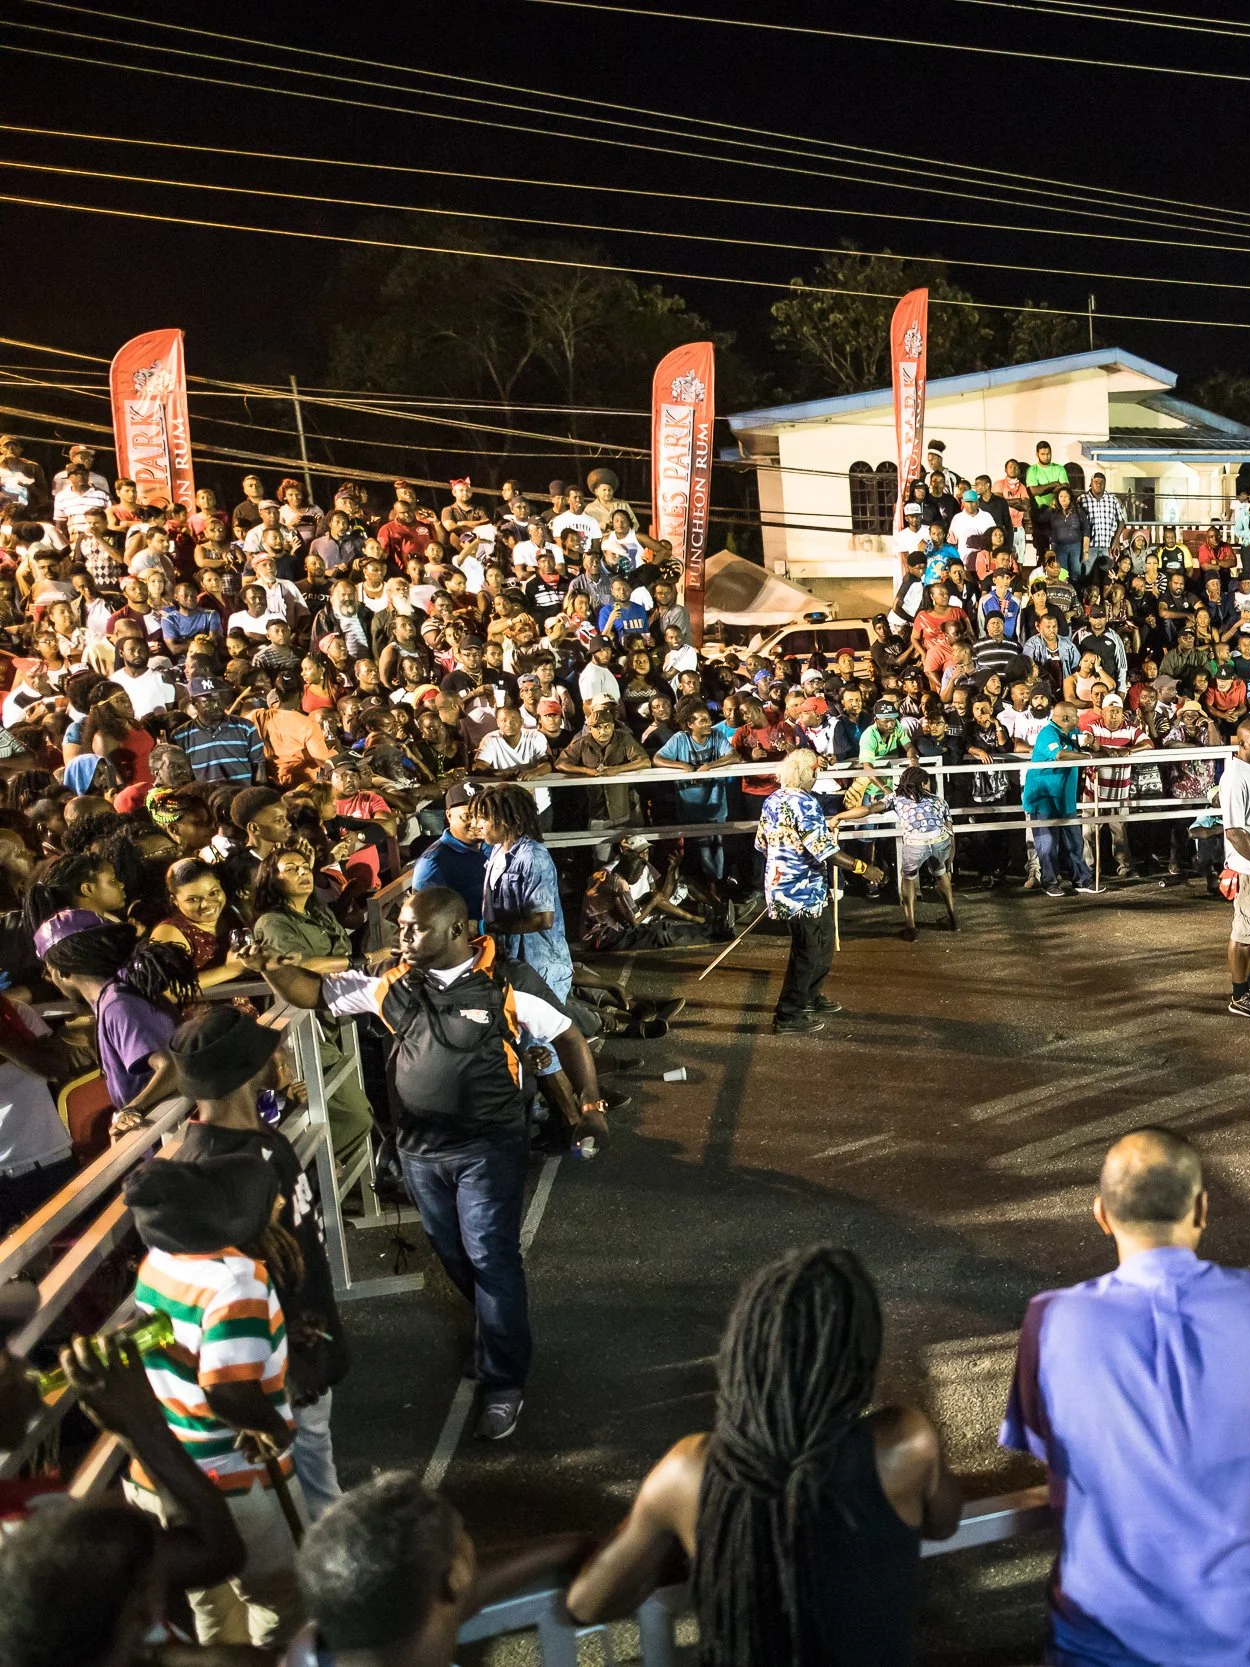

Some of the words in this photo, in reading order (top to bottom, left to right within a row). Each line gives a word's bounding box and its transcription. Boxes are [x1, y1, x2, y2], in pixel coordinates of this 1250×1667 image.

[130, 405, 168, 486] PARK
[171, 418, 190, 469] RUM
[663, 409, 692, 482] PARK
[696, 423, 709, 469] RUM
[689, 478, 706, 587] PUNCHEON
